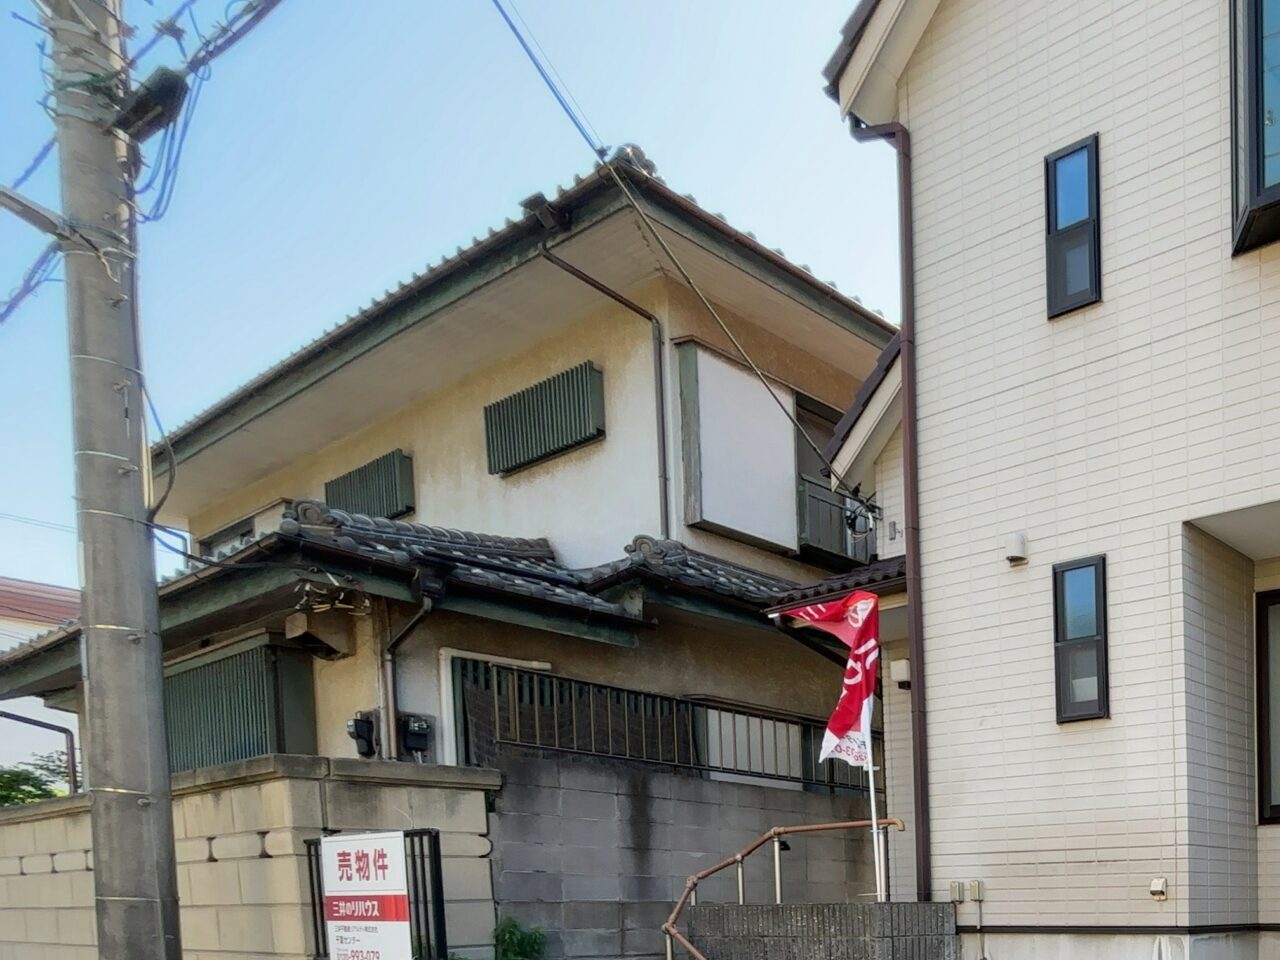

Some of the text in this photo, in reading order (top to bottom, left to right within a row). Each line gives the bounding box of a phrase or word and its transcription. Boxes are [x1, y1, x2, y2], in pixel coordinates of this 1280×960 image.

[337, 848, 389, 882] 売物件
[332, 900, 380, 917] 三井のリハウス
